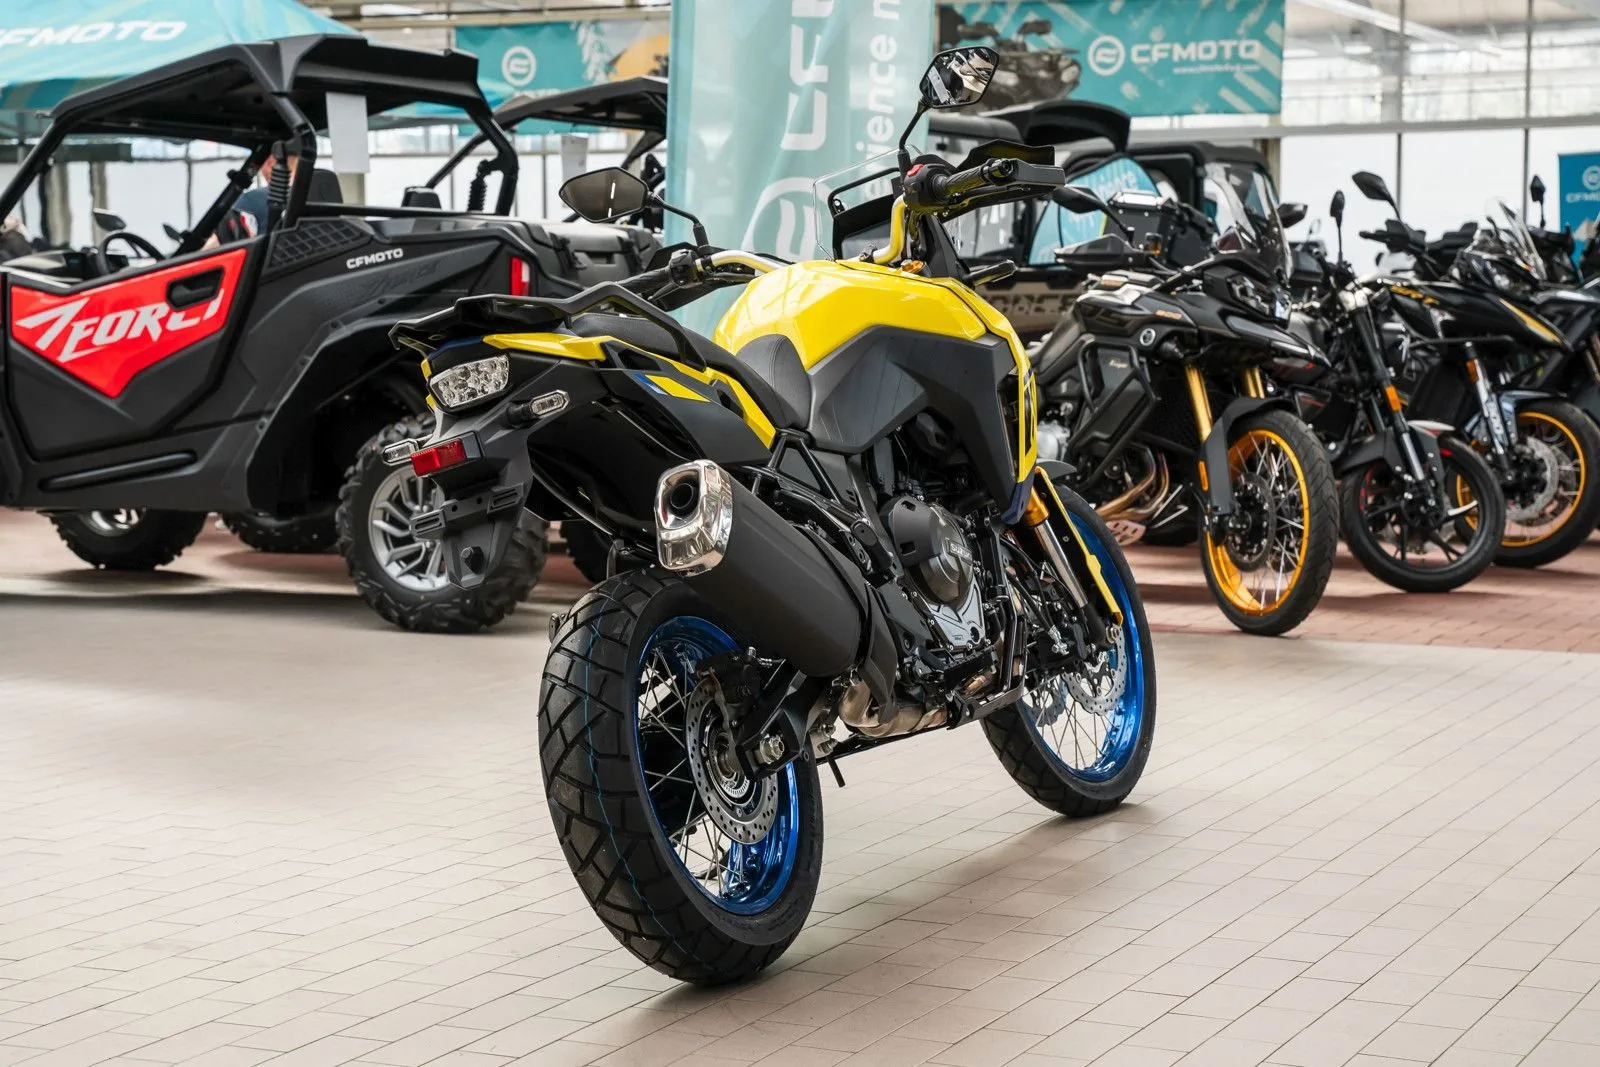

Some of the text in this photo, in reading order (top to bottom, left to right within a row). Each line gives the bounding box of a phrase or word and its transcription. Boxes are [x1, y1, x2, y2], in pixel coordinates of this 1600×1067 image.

[0, 20, 187, 47] FMOTO
[1131, 39, 1261, 65] CFMOTO
[346, 247, 404, 269] CFMOTO
